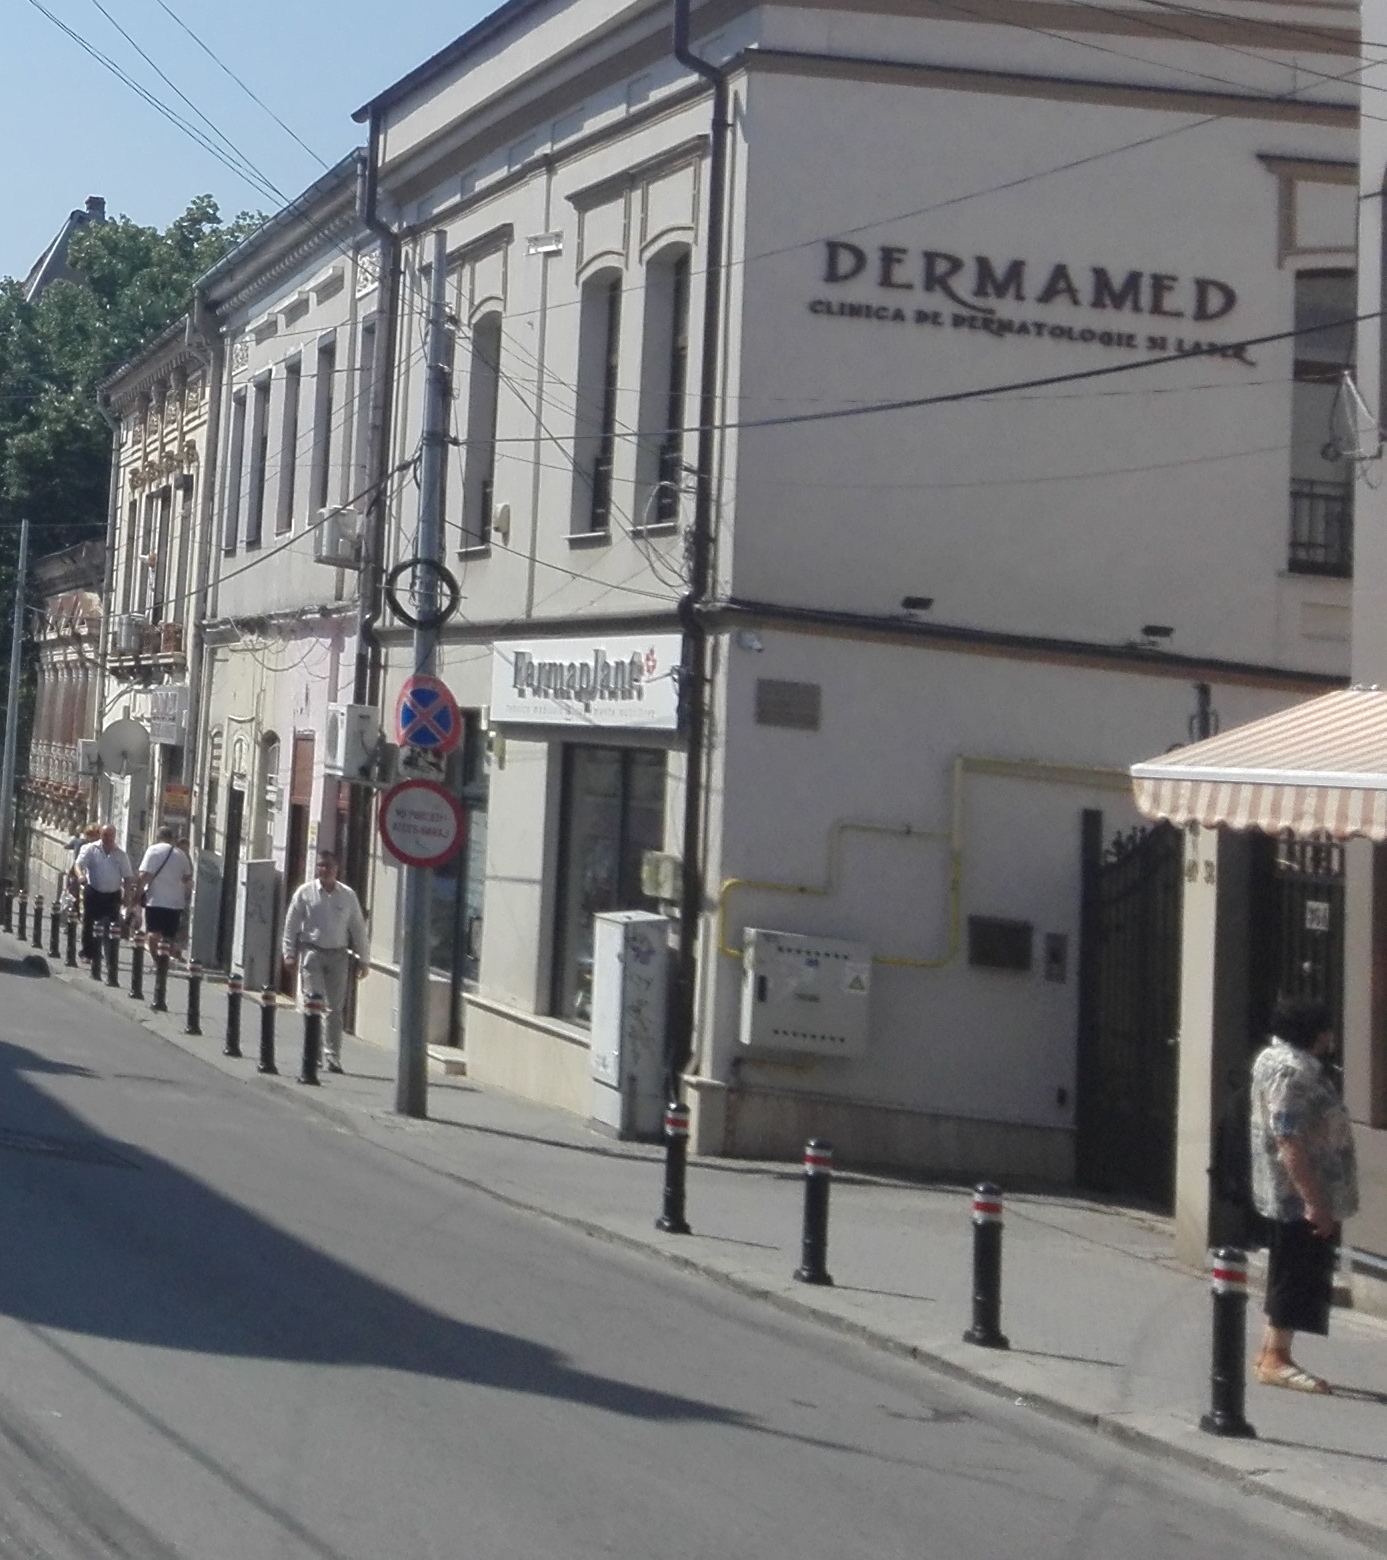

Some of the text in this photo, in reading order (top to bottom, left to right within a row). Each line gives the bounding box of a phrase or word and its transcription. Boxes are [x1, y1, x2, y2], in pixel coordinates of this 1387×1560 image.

[824, 240, 1237, 321] DERMAMED
[809, 300, 906, 322] CLINICA
[913, 309, 944, 326] DE
[951, 312, 1137, 349] DERMATOLOGIE
